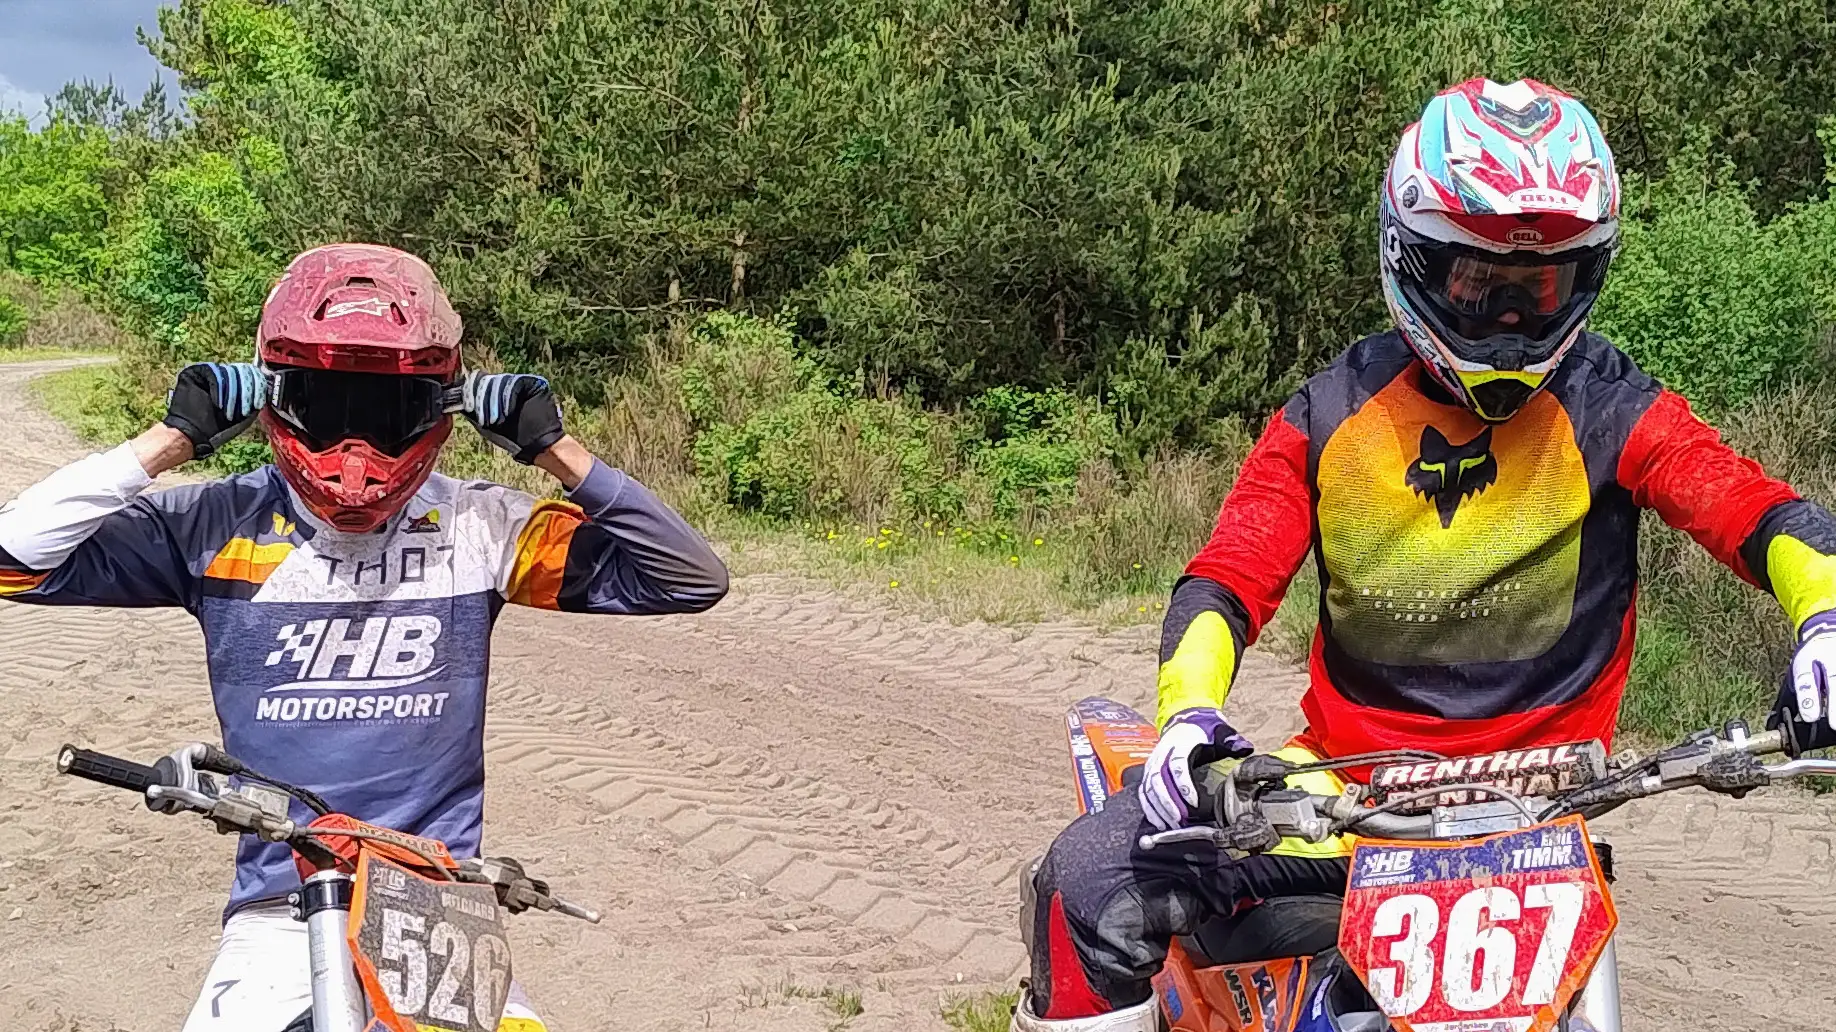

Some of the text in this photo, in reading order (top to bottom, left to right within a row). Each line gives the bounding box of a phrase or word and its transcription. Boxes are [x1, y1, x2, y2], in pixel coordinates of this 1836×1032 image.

[1512, 232, 1541, 242] BELL
[307, 615, 443, 679] HB
[255, 692, 450, 721] MOTORSPORT
[1380, 745, 1578, 786] RENTHAL
[1079, 757, 1105, 816] MOTORSPO
[1512, 845, 1572, 870] TIMM
[1359, 873, 1416, 887] MOTORSPORT
[378, 908, 510, 1032] 526
[1368, 882, 1585, 1017] 367
